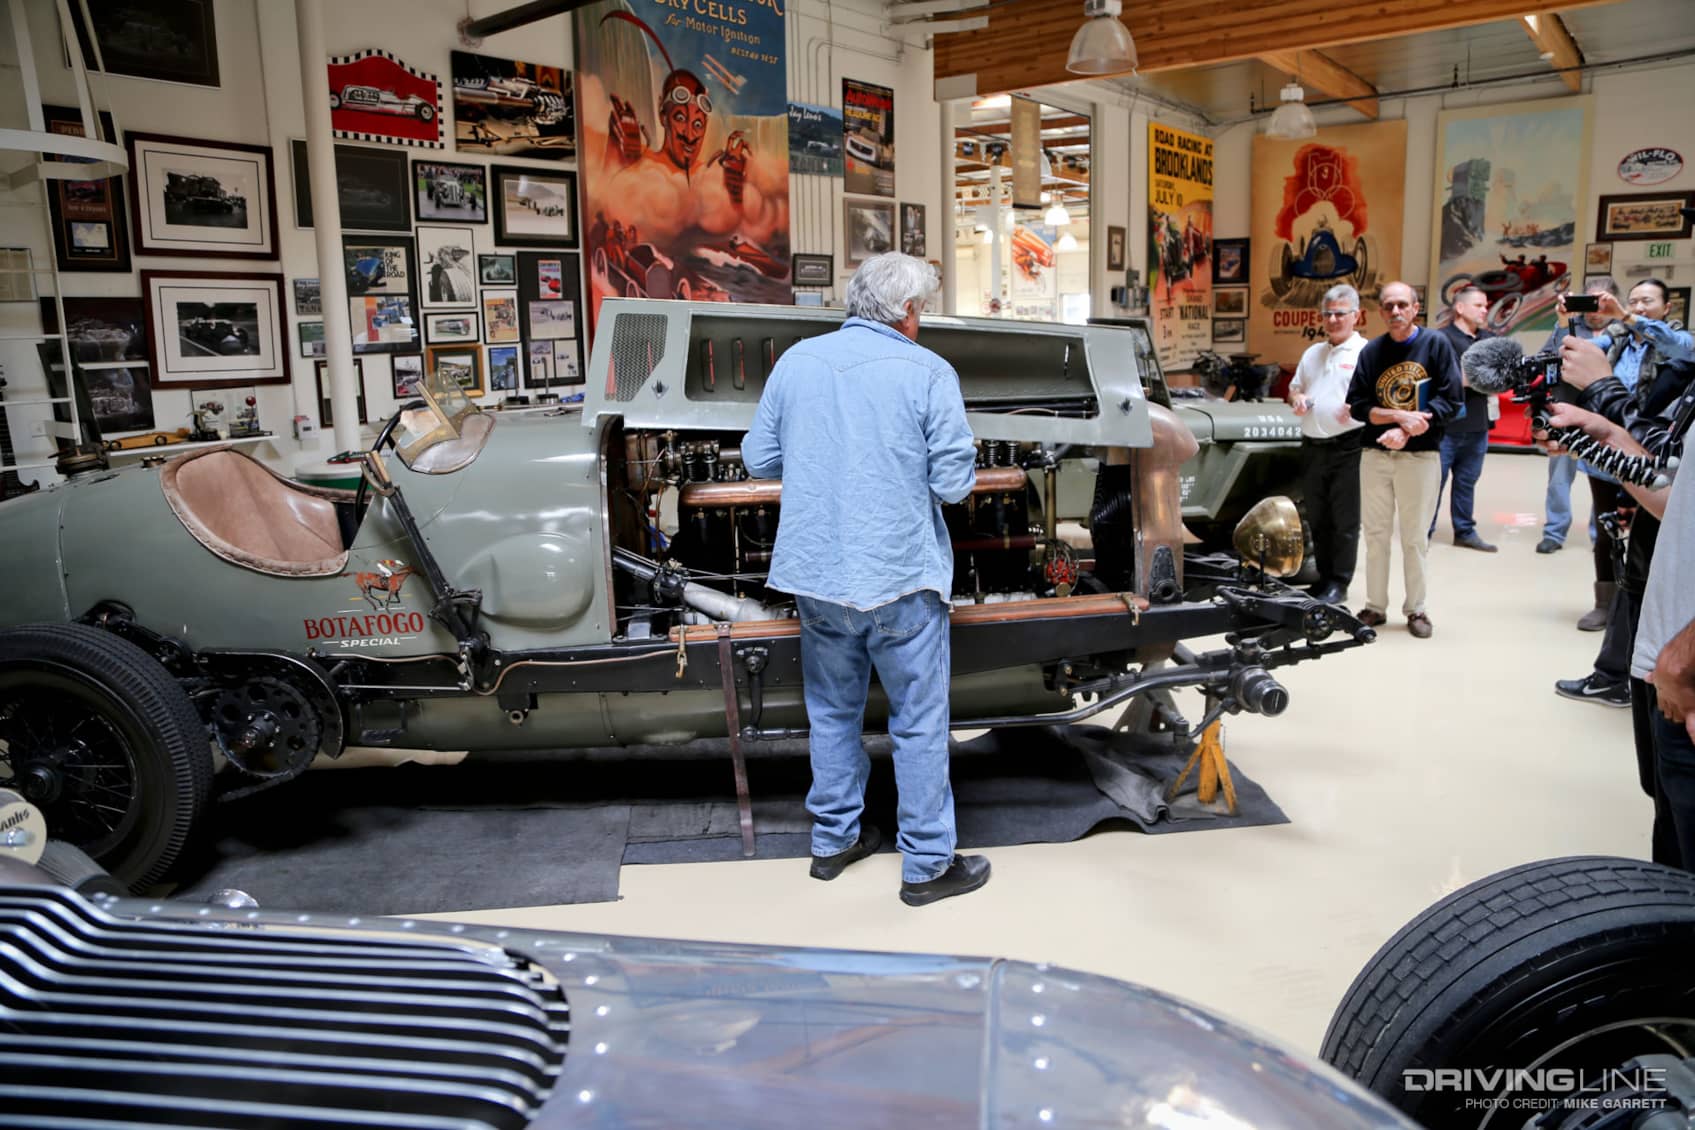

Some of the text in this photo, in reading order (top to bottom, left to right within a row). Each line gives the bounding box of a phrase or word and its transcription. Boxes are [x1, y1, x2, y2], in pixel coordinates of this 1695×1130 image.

[694, 0, 748, 25] CELLS
[664, 13, 761, 43] for Motor Ignition
[1155, 128, 1175, 147] ROAD
[1155, 146, 1213, 187] BROOKLANDS
[1649, 243, 1673, 258] EXIT
[1273, 311, 1317, 327] COUPE
[1301, 325, 1329, 341] 194
[1243, 426, 1302, 438] 2034042
[303, 611, 425, 640] BOTAFOGO
[340, 637, 401, 649] SPECIAL
